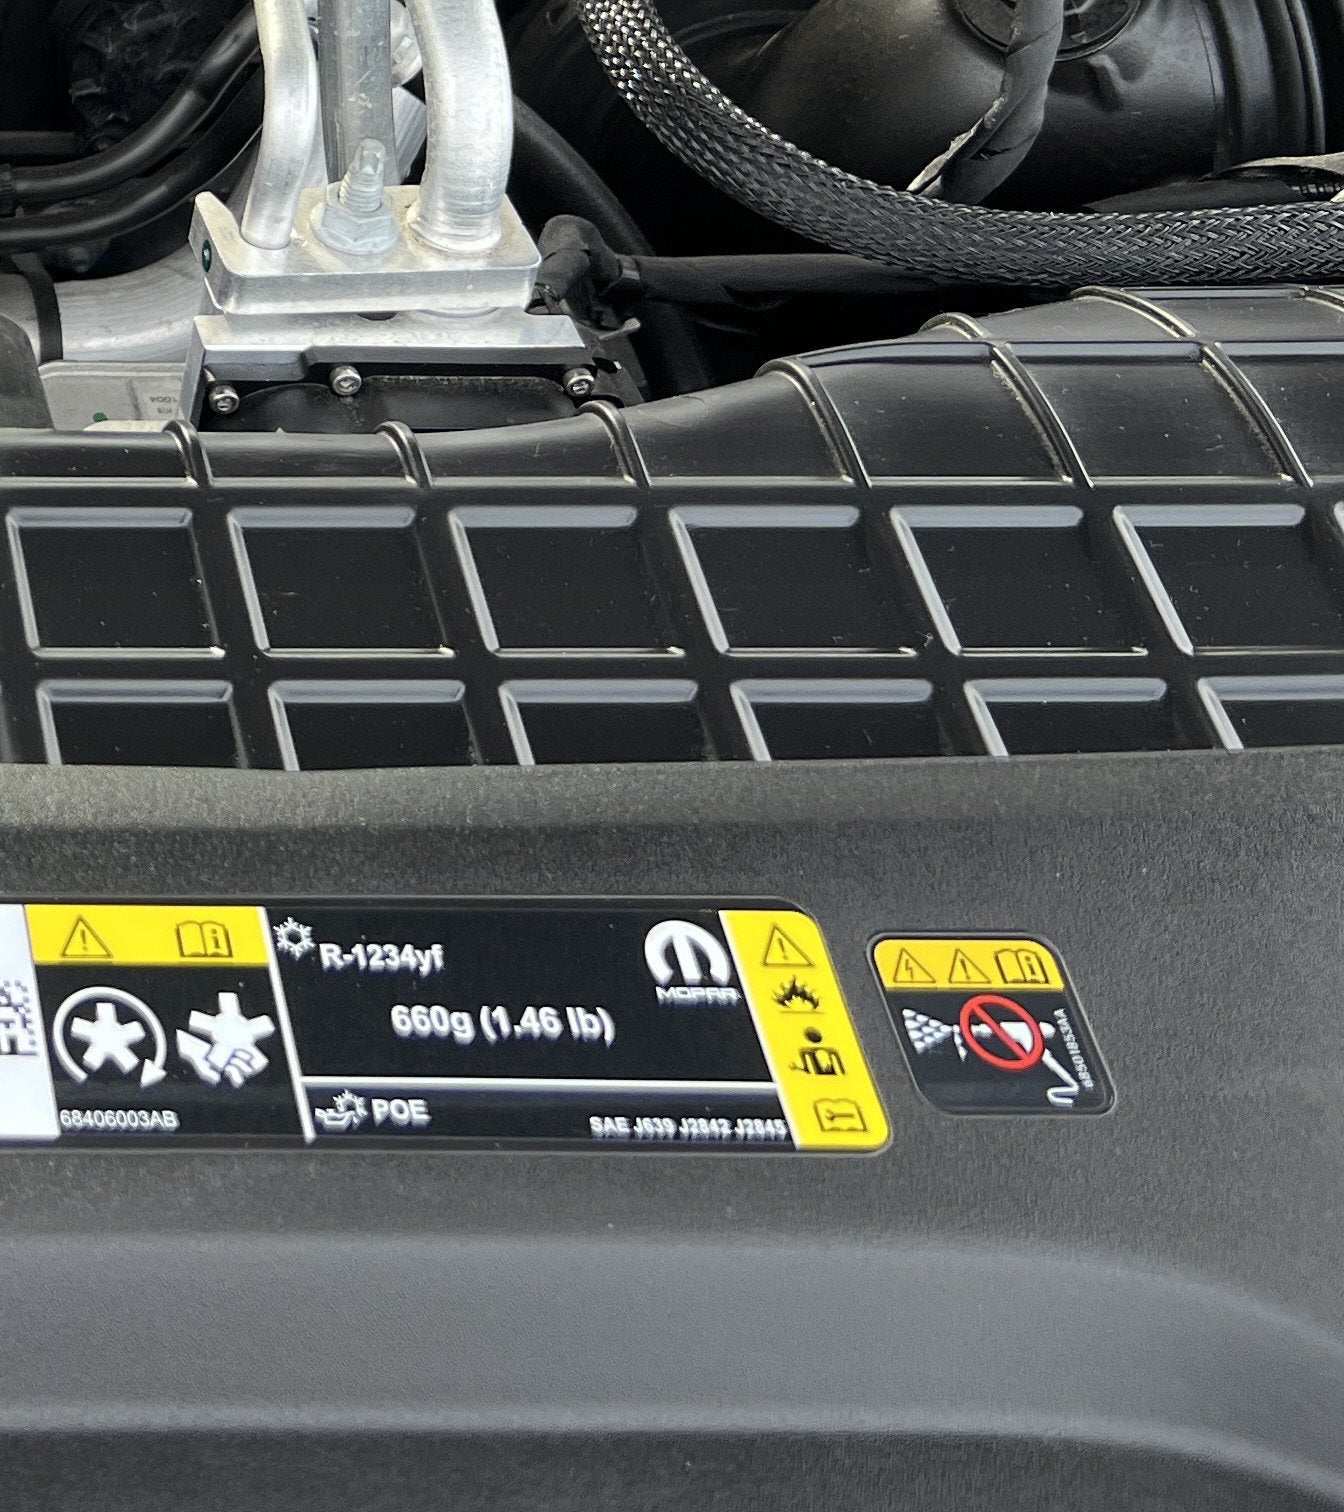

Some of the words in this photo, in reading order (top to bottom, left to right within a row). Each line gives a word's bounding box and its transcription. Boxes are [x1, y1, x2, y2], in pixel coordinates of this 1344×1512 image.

[319, 943, 444, 977] R-1234yf
[391, 1005, 475, 1045] 660g
[479, 1005, 563, 1045] (1.46
[567, 1006, 616, 1047] lb)
[59, 1109, 180, 1131] 68406003AB
[371, 1098, 432, 1127] POE
[589, 1116, 630, 1139] SAE
